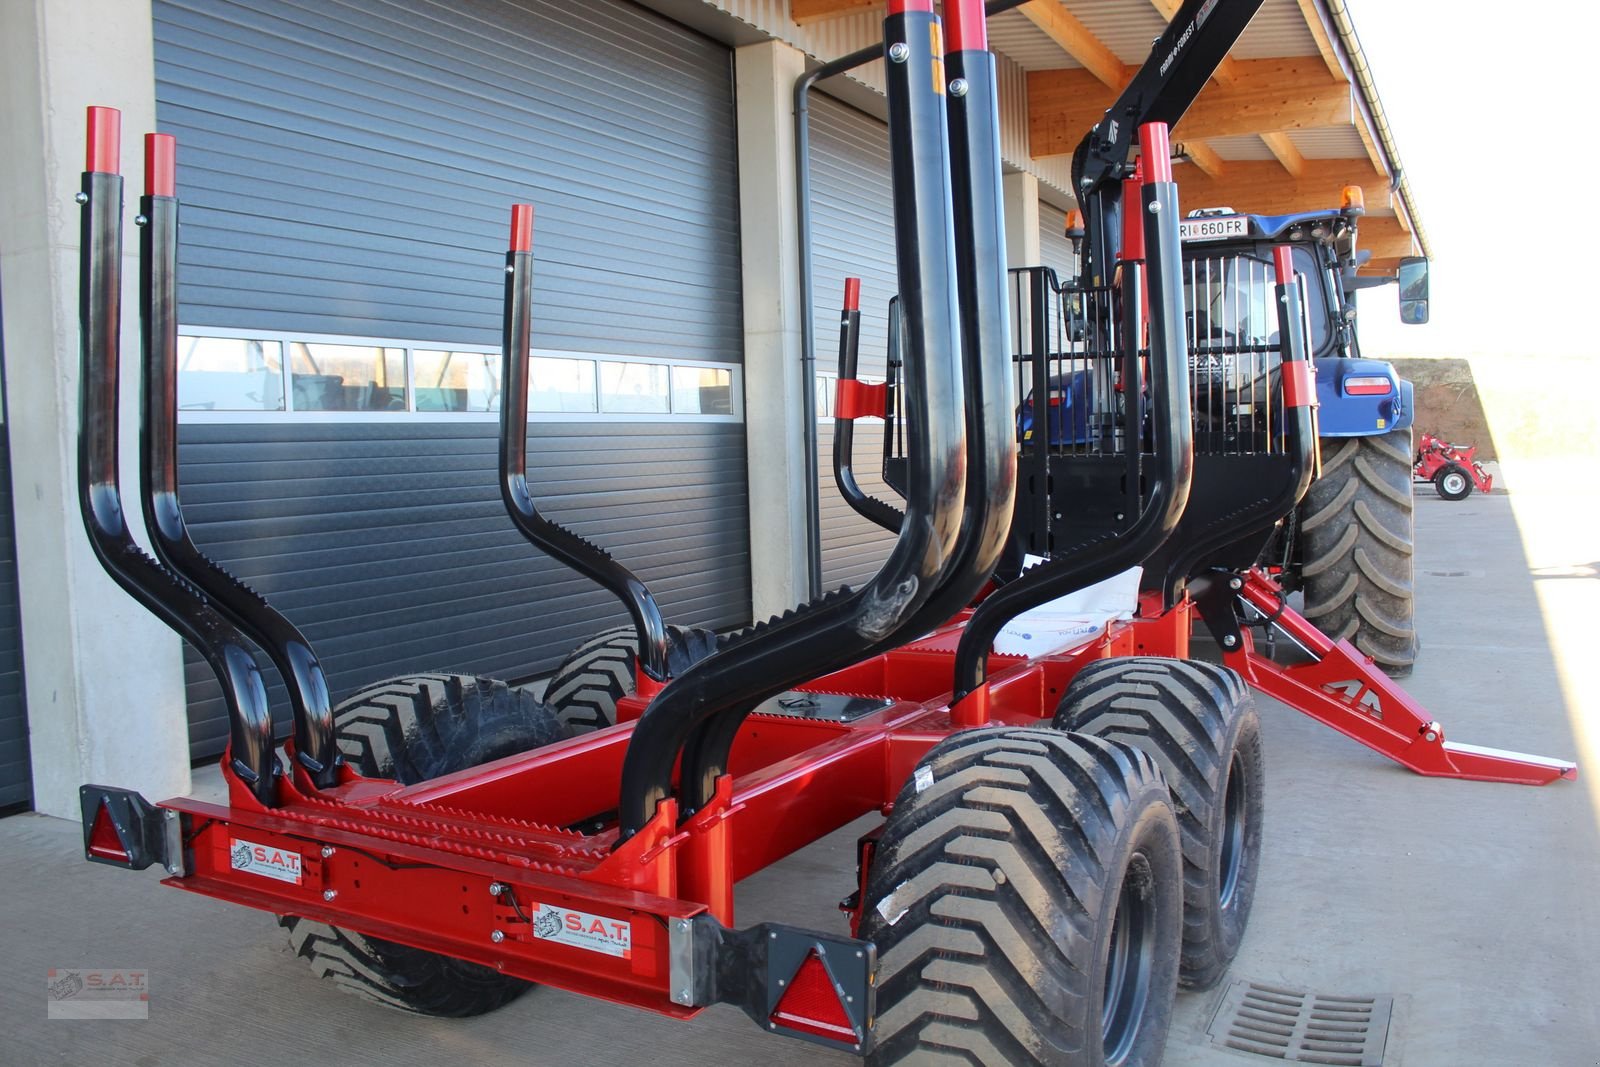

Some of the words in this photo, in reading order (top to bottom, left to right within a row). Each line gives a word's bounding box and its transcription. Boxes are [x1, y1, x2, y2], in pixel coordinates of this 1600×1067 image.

[1177, 20, 1195, 52] FOREST
[1180, 225, 1191, 237] RI
[254, 847, 299, 871] S.A.T.
[565, 913, 628, 942] S.A.T.
